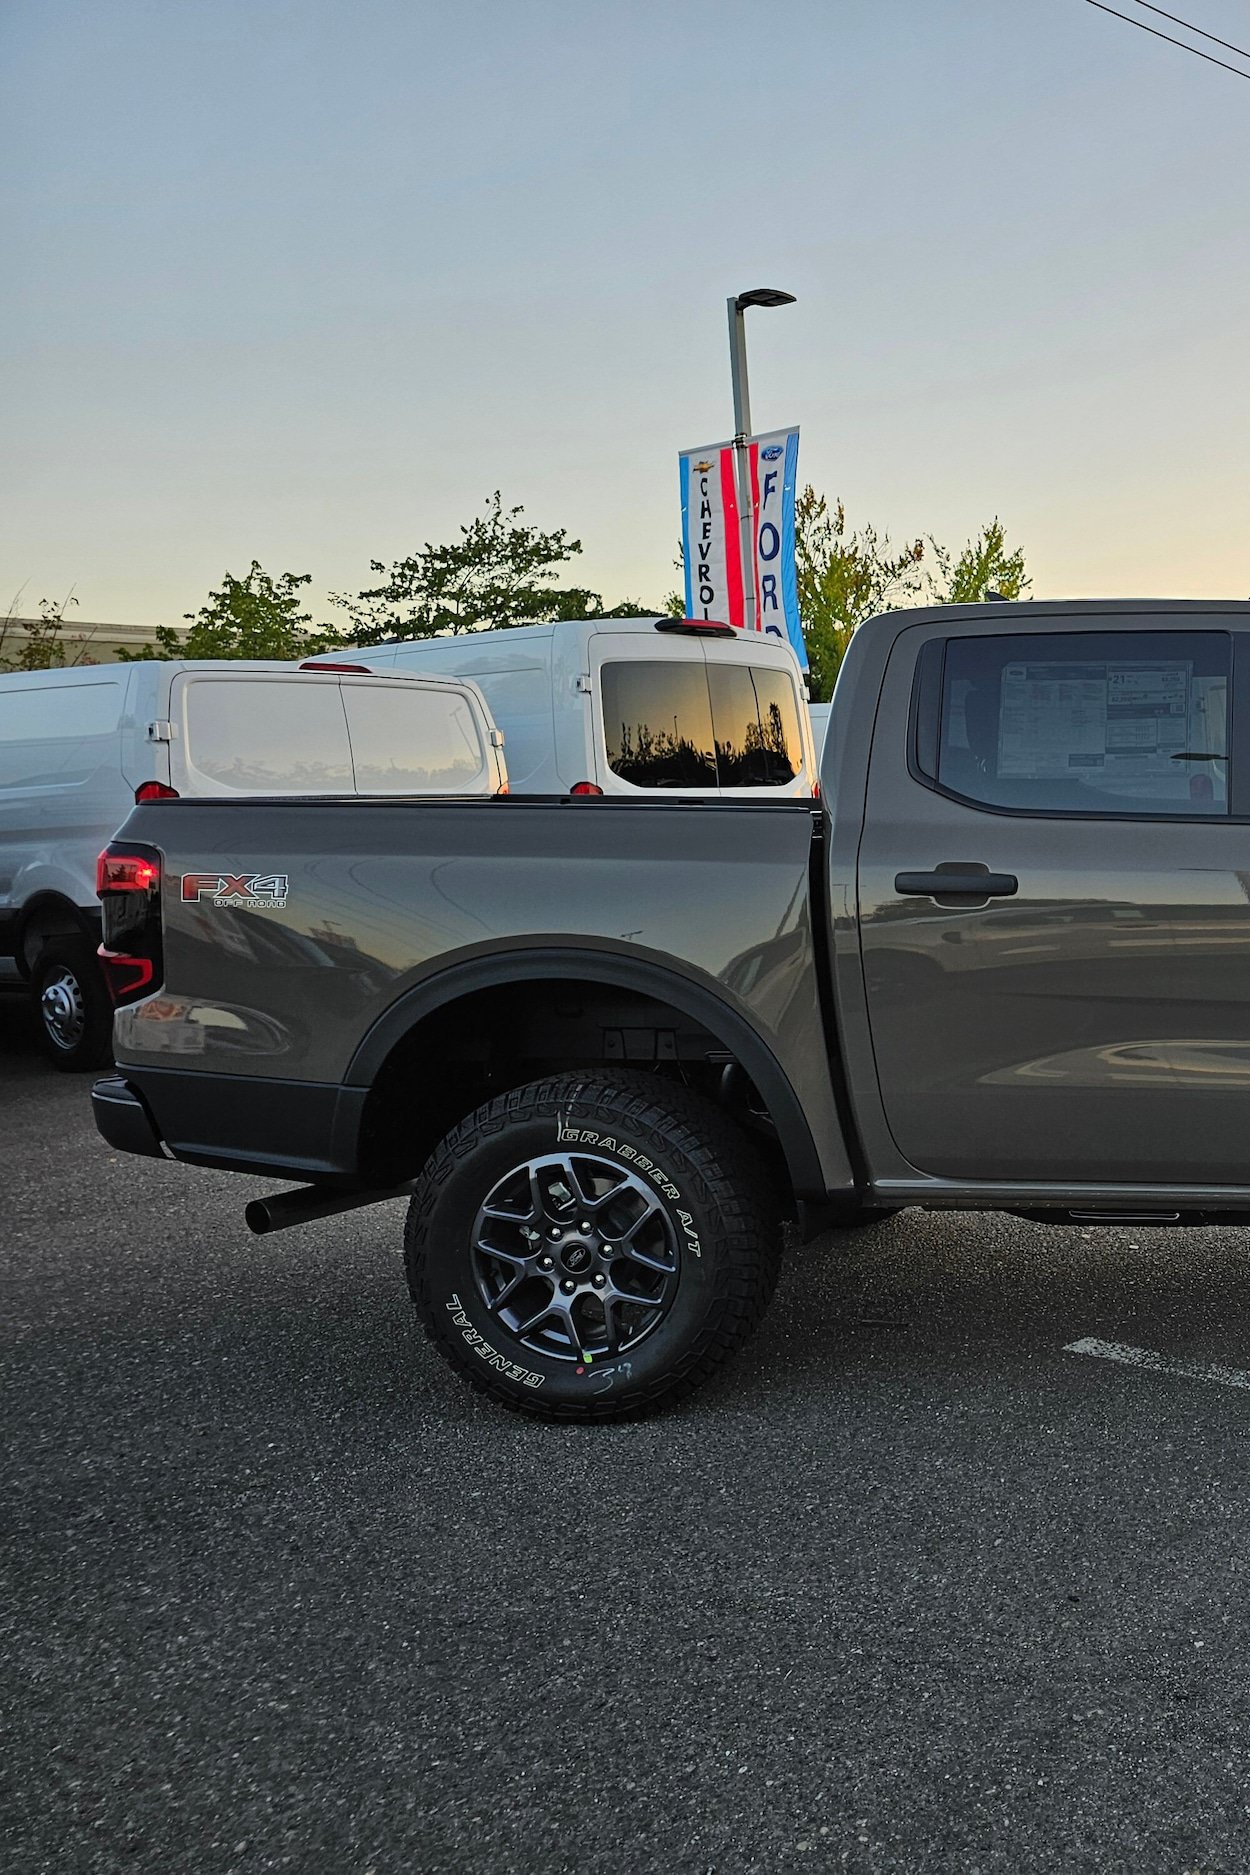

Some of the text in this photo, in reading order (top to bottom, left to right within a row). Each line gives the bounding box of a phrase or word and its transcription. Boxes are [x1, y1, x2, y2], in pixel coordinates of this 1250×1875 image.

[181, 873, 288, 902] FX4
[213, 899, 287, 909] OFF ROAD
[561, 1129, 701, 1257] GRABBER A/T
[445, 1293, 546, 1389] GENERAL
